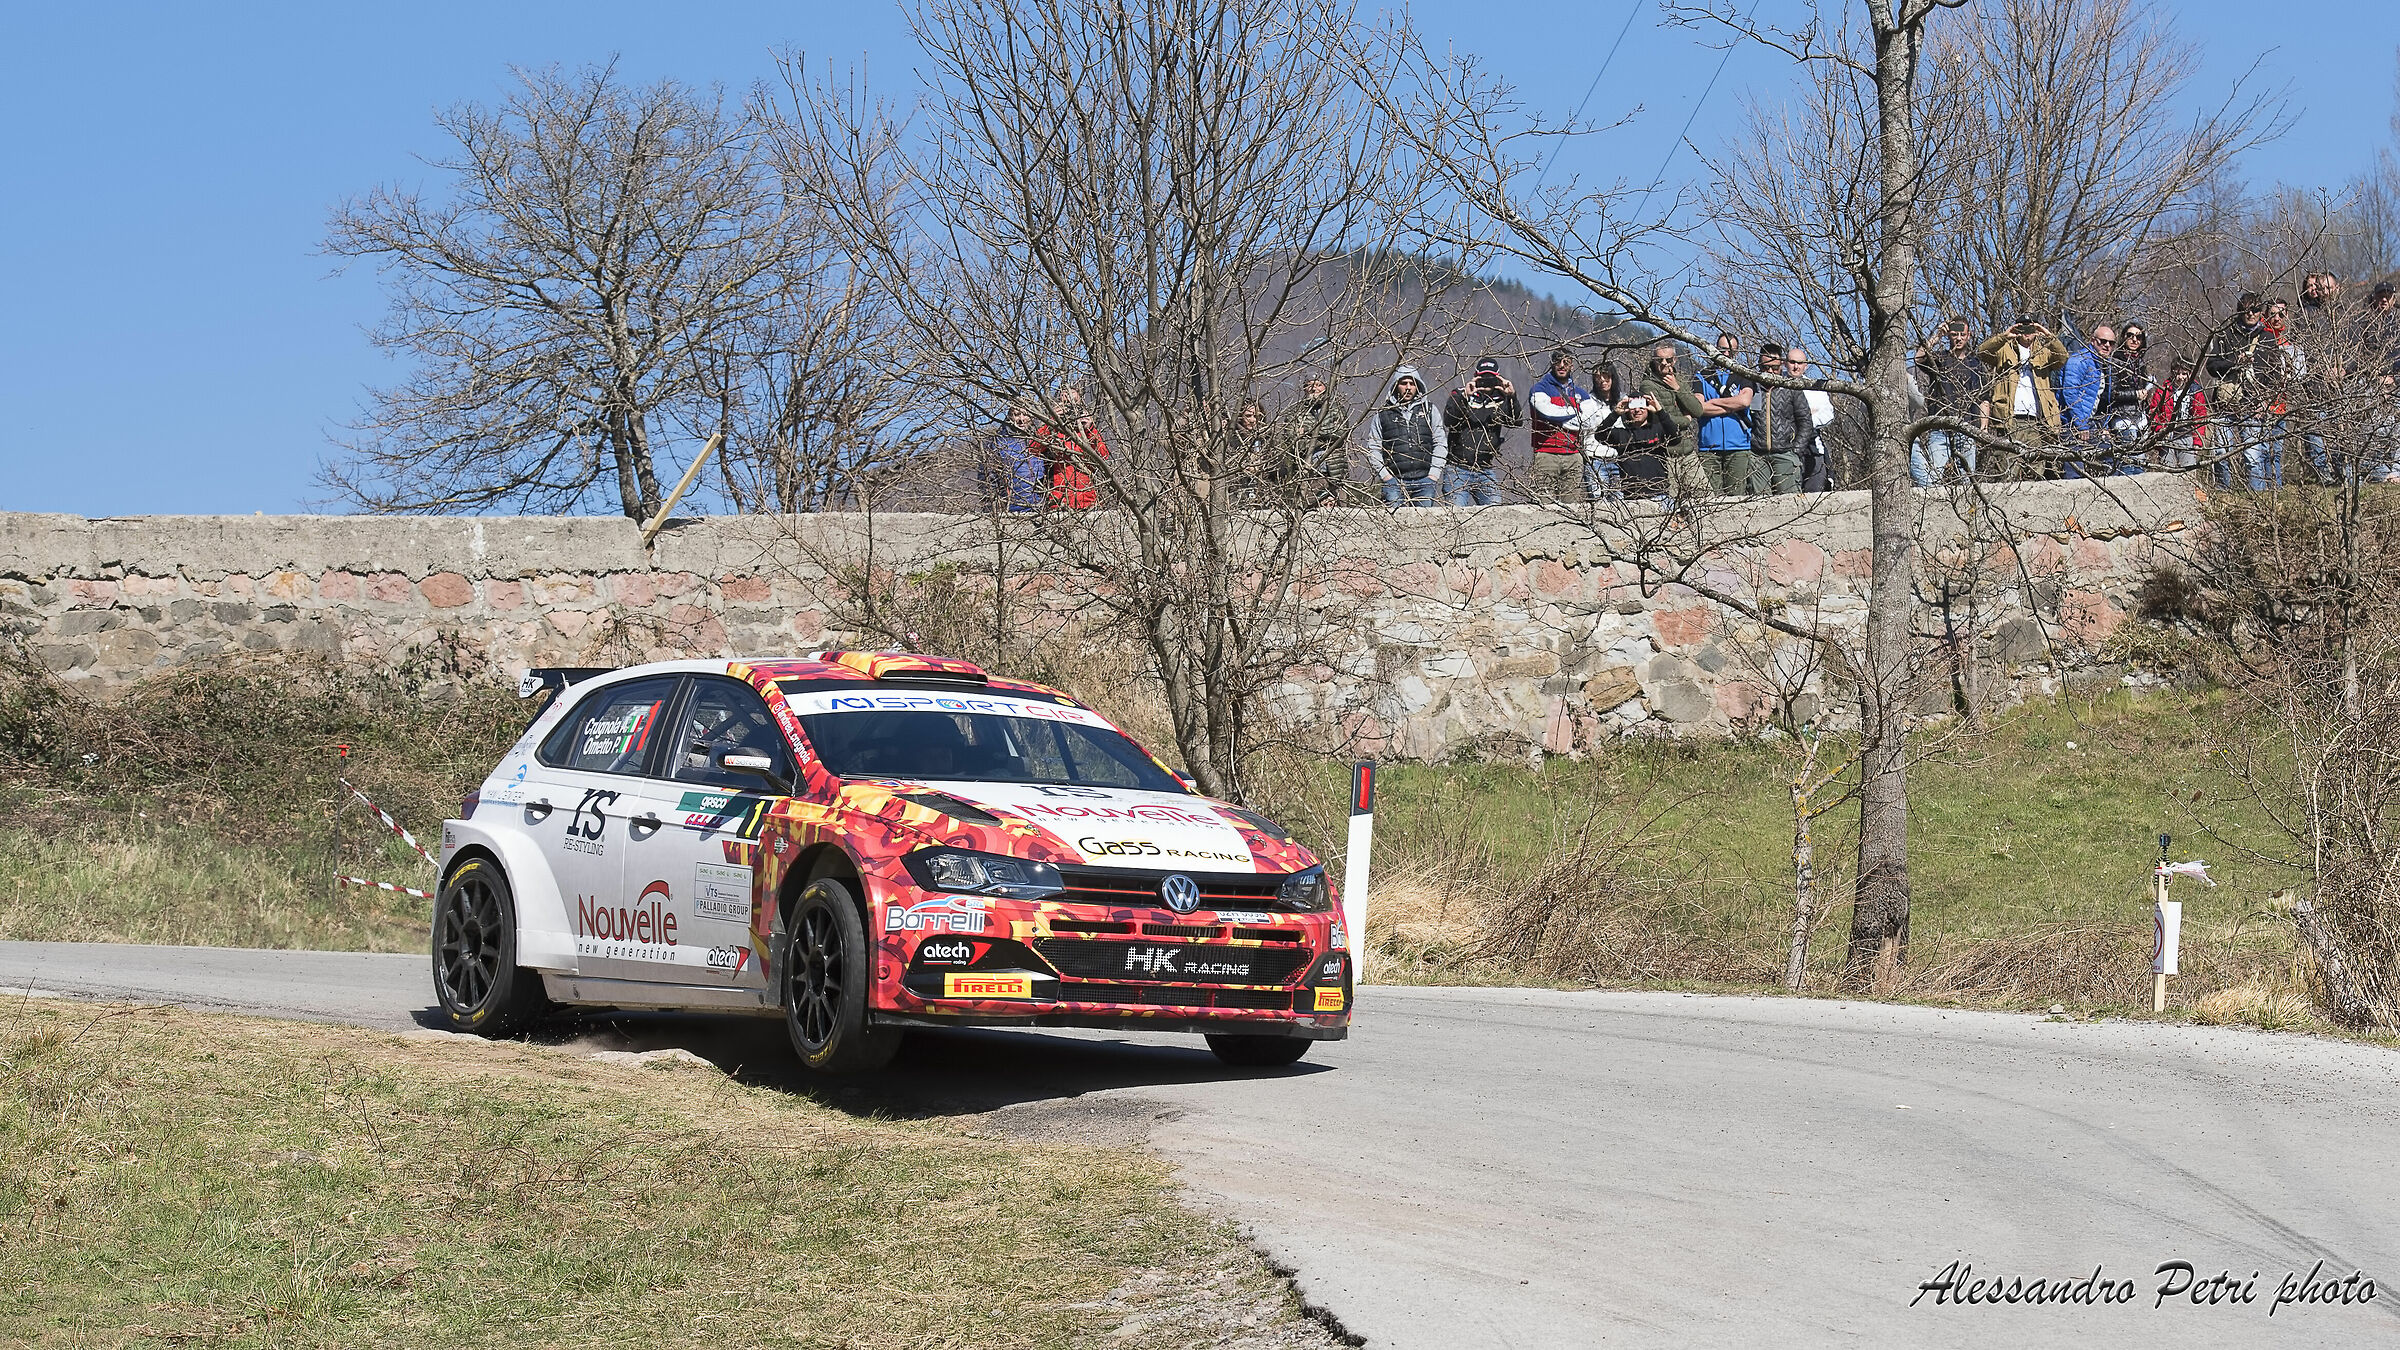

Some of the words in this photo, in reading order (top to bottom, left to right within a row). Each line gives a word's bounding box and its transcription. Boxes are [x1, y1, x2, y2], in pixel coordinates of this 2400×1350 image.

[521, 677, 537, 689] HK
[583, 716, 619, 740] Crugnola
[582, 736, 613, 756] Ometto
[744, 800, 767, 838] 1
[1166, 849, 1250, 863] RACING
[699, 900, 727, 913] PALLADIO
[728, 903, 749, 916] GROUP
[578, 892, 678, 947] Nouvelle
[886, 906, 984, 932] Borrelli
[577, 943, 599, 954] new
[605, 946, 676, 961] generation
[706, 945, 737, 969] atech
[923, 941, 970, 959] atech
[1124, 946, 1181, 972] HK
[1183, 961, 1250, 976] RACING
[953, 977, 1023, 993] PIRELLI
